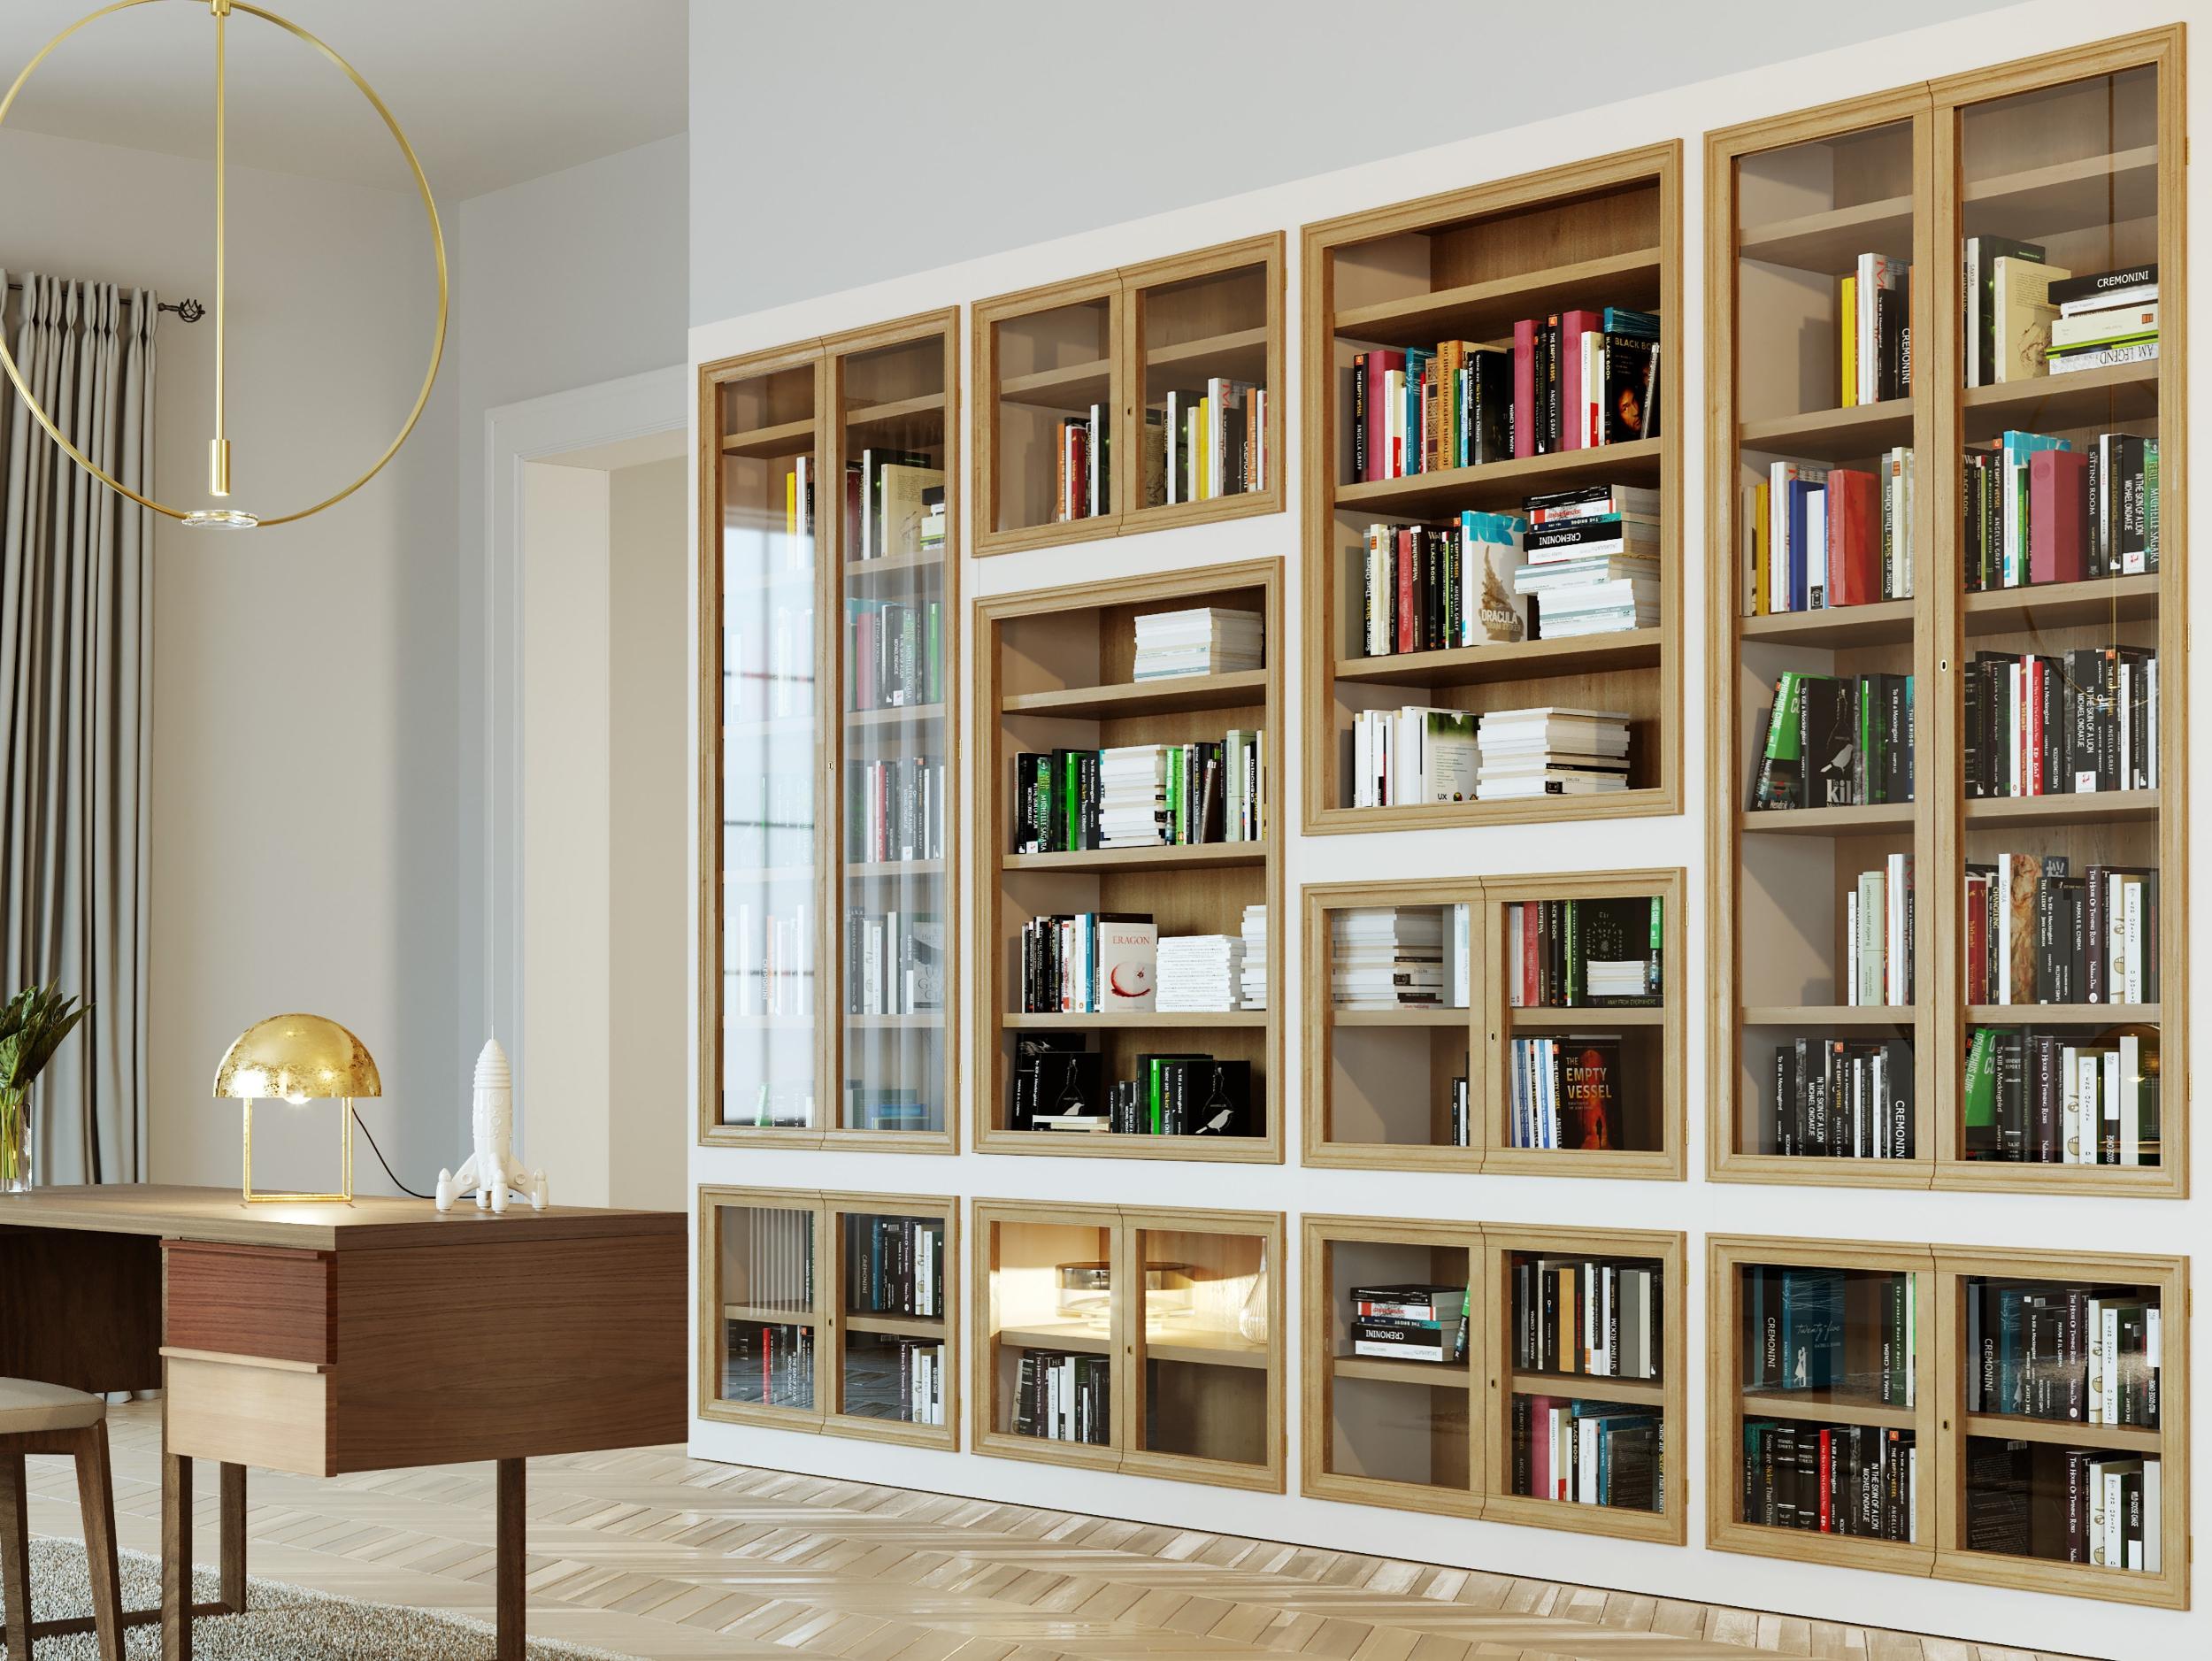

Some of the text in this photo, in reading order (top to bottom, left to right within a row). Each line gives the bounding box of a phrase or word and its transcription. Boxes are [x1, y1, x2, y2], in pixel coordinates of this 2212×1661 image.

[2097, 271, 2148, 288] CREMONINI
[2101, 346, 2133, 364] LEGEND
[2148, 461, 2159, 563] PERIL MICHELLE SAGARA
[1539, 533, 1581, 545] CREMONINI
[1481, 609, 1518, 624] DRACULA
[1112, 935, 1149, 944] ERAGON
[1566, 1068, 1607, 1081] EMPTY
[1567, 1085, 1612, 1098] VESSEL
[1895, 1100, 1904, 1159] CREMONIN
[1365, 1330, 1404, 1340] CREMONINI
[1045, 1357, 1062, 1368] THE
